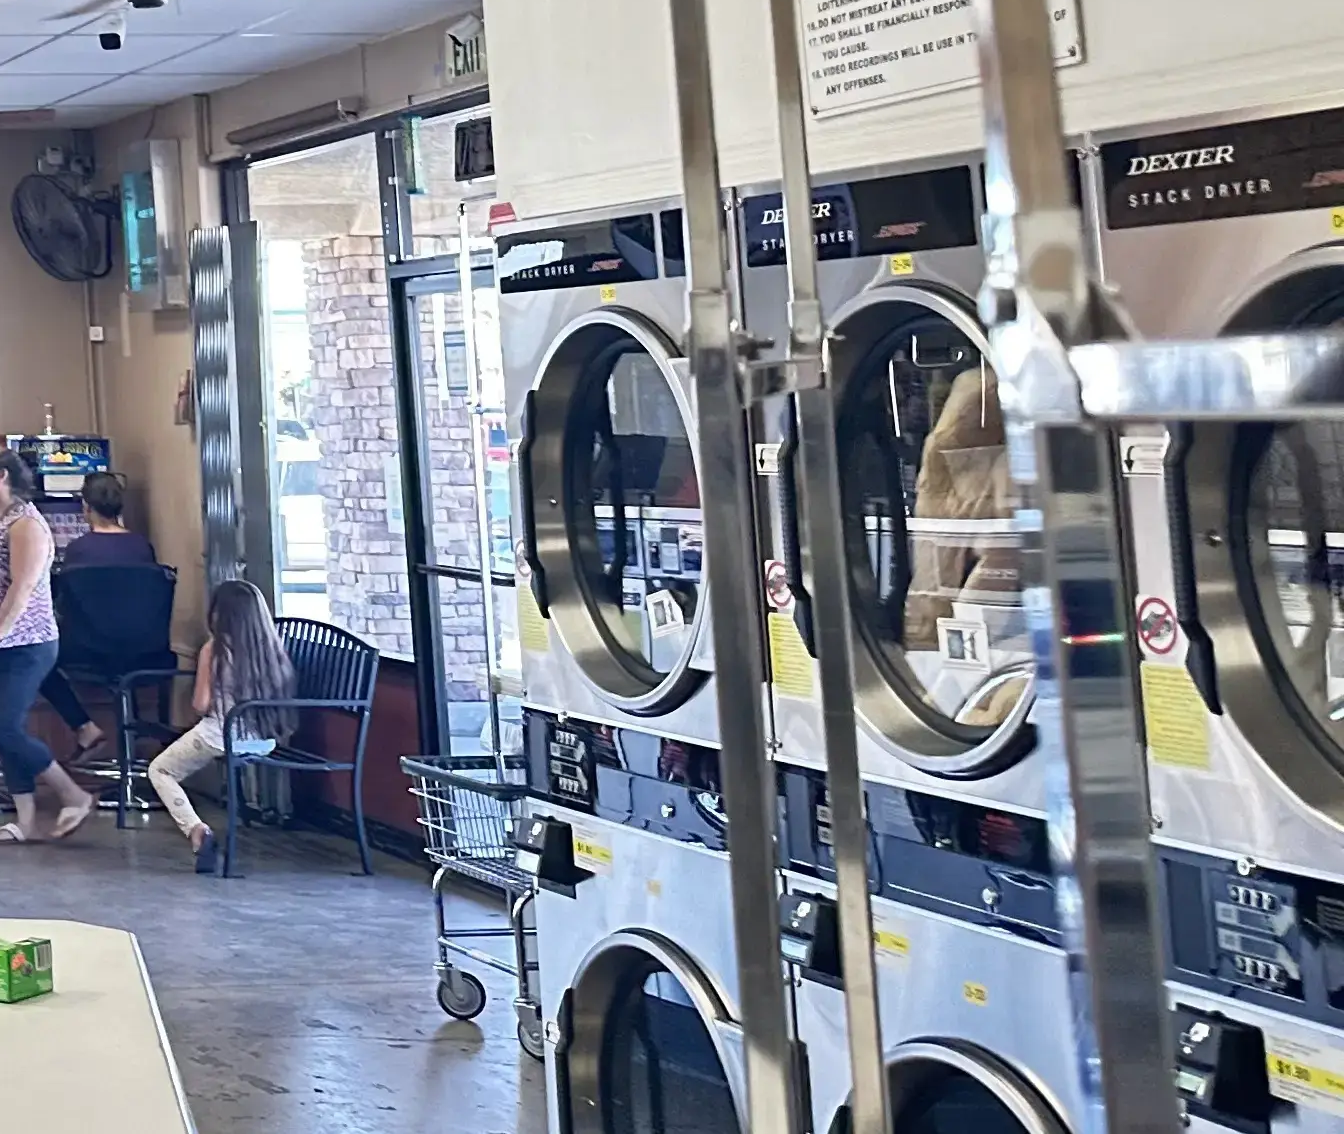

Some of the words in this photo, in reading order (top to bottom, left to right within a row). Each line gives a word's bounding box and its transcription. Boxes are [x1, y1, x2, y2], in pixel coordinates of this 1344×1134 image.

[817, 16, 829, 30] DO
[830, 11, 847, 26] NOT
[848, 0, 888, 22] MISTREAT
[819, 31, 836, 47] YOU
[837, 24, 862, 42] SHALL
[864, 21, 875, 35] BE
[876, 6, 931, 32] FINANCIALLY
[822, 47, 839, 62] YOU
[822, 63, 846, 79] VIDEO
[847, 50, 899, 73] RECORDINGS
[900, 44, 920, 60] WILL
[922, 41, 934, 55] BE
[935, 36, 953, 52] USE
[955, 33, 965, 47] IN
[825, 83, 841, 97] ANY
[843, 72, 886, 93] OFFENSES.
[1126, 145, 1235, 177] DEXTER
[1128, 187, 1192, 209] STACK
[1205, 178, 1273, 200] DRYER
[761, 202, 832, 225] DEER
[813, 229, 856, 245] DRYER
[544, 263, 576, 277] DRYER
